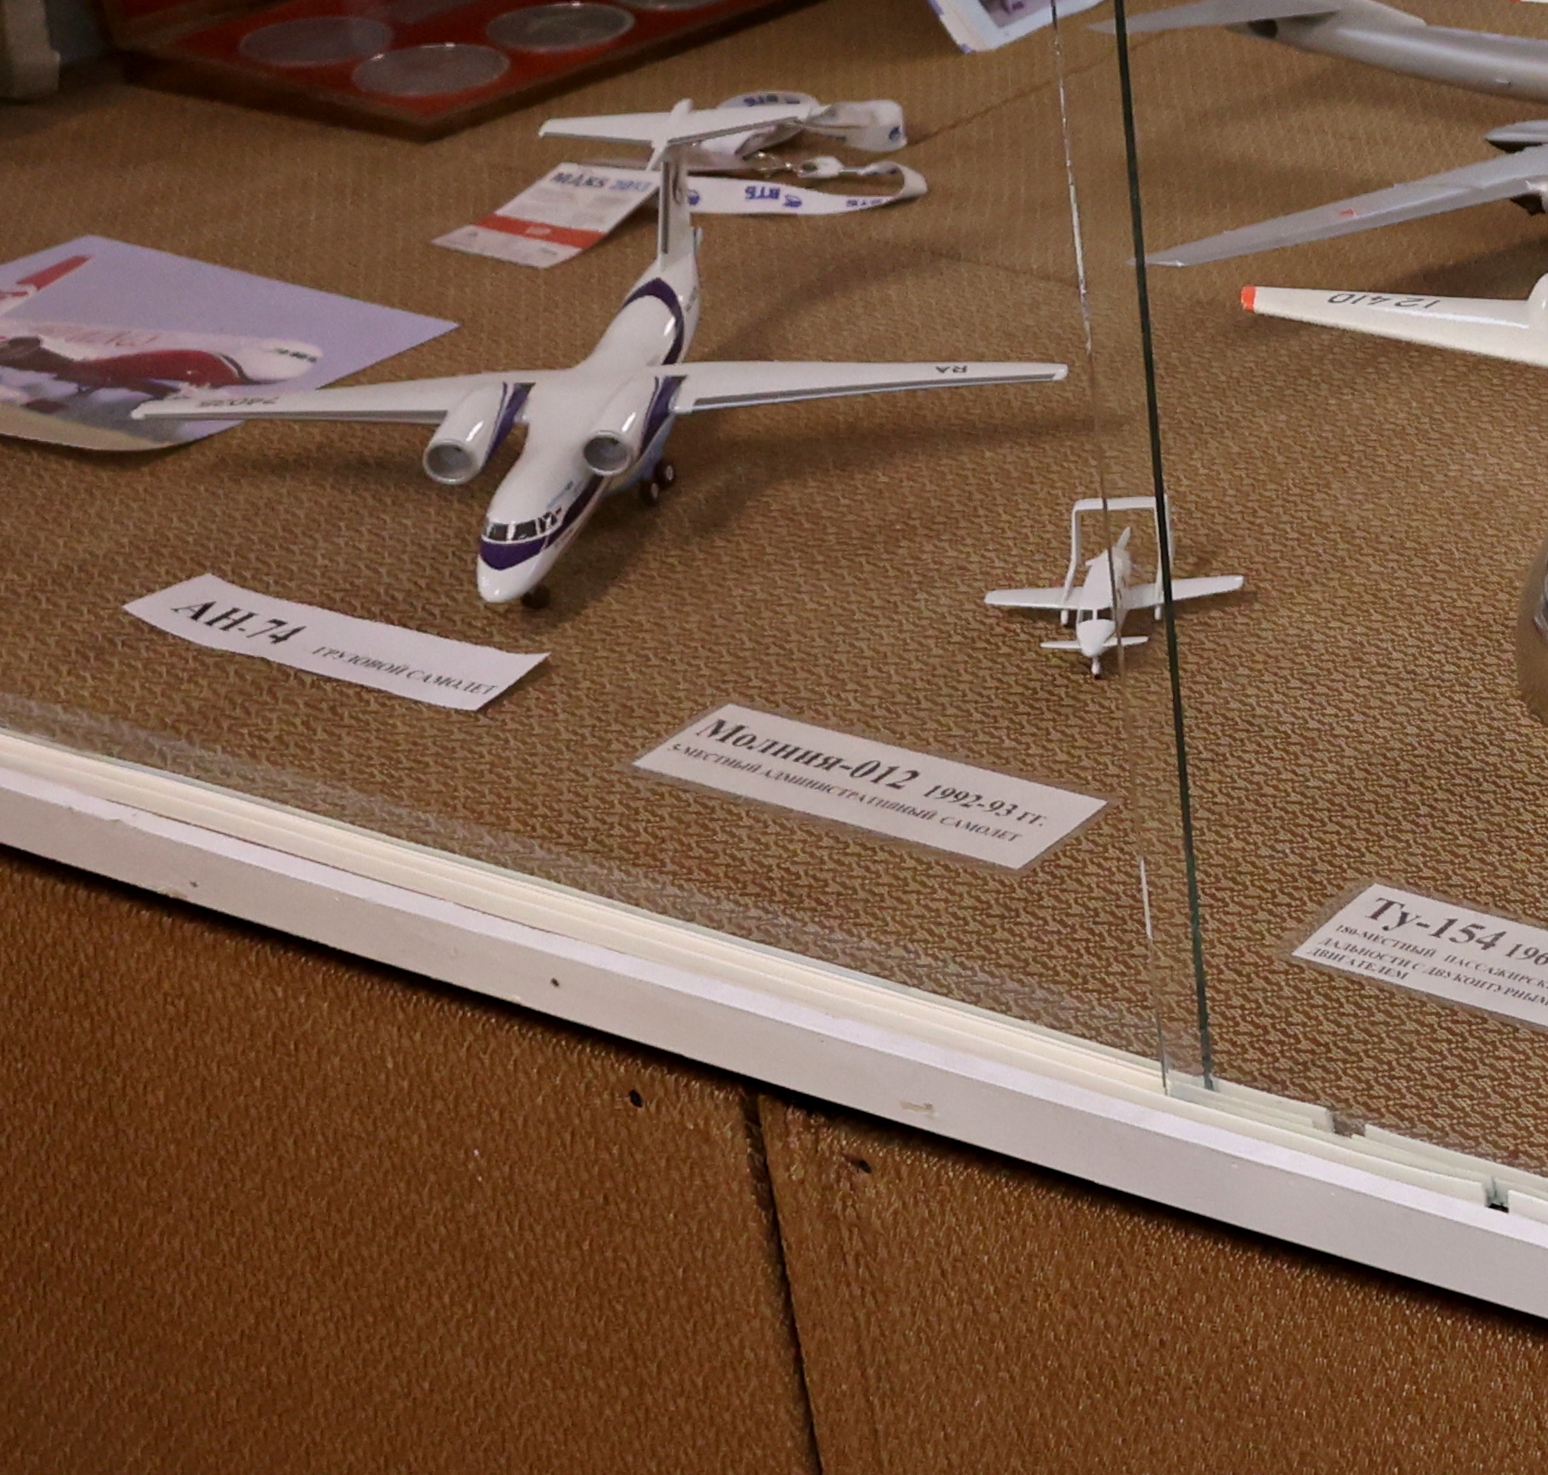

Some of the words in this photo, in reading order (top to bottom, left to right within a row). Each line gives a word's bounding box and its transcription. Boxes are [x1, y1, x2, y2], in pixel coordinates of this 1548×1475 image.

[744, 185, 782, 201] ВТБ
[696, 718, 920, 791] Молния-012
[923, 783, 1019, 820] 1992-93
[938, 815, 1023, 843] САМОЛЕТ
[1364, 897, 1507, 952] Ту-154
[1306, 947, 1410, 981] ДВИГАТЕЛЕМ
[1317, 936, 1411, 969] ДАЛЬНОСТИ
